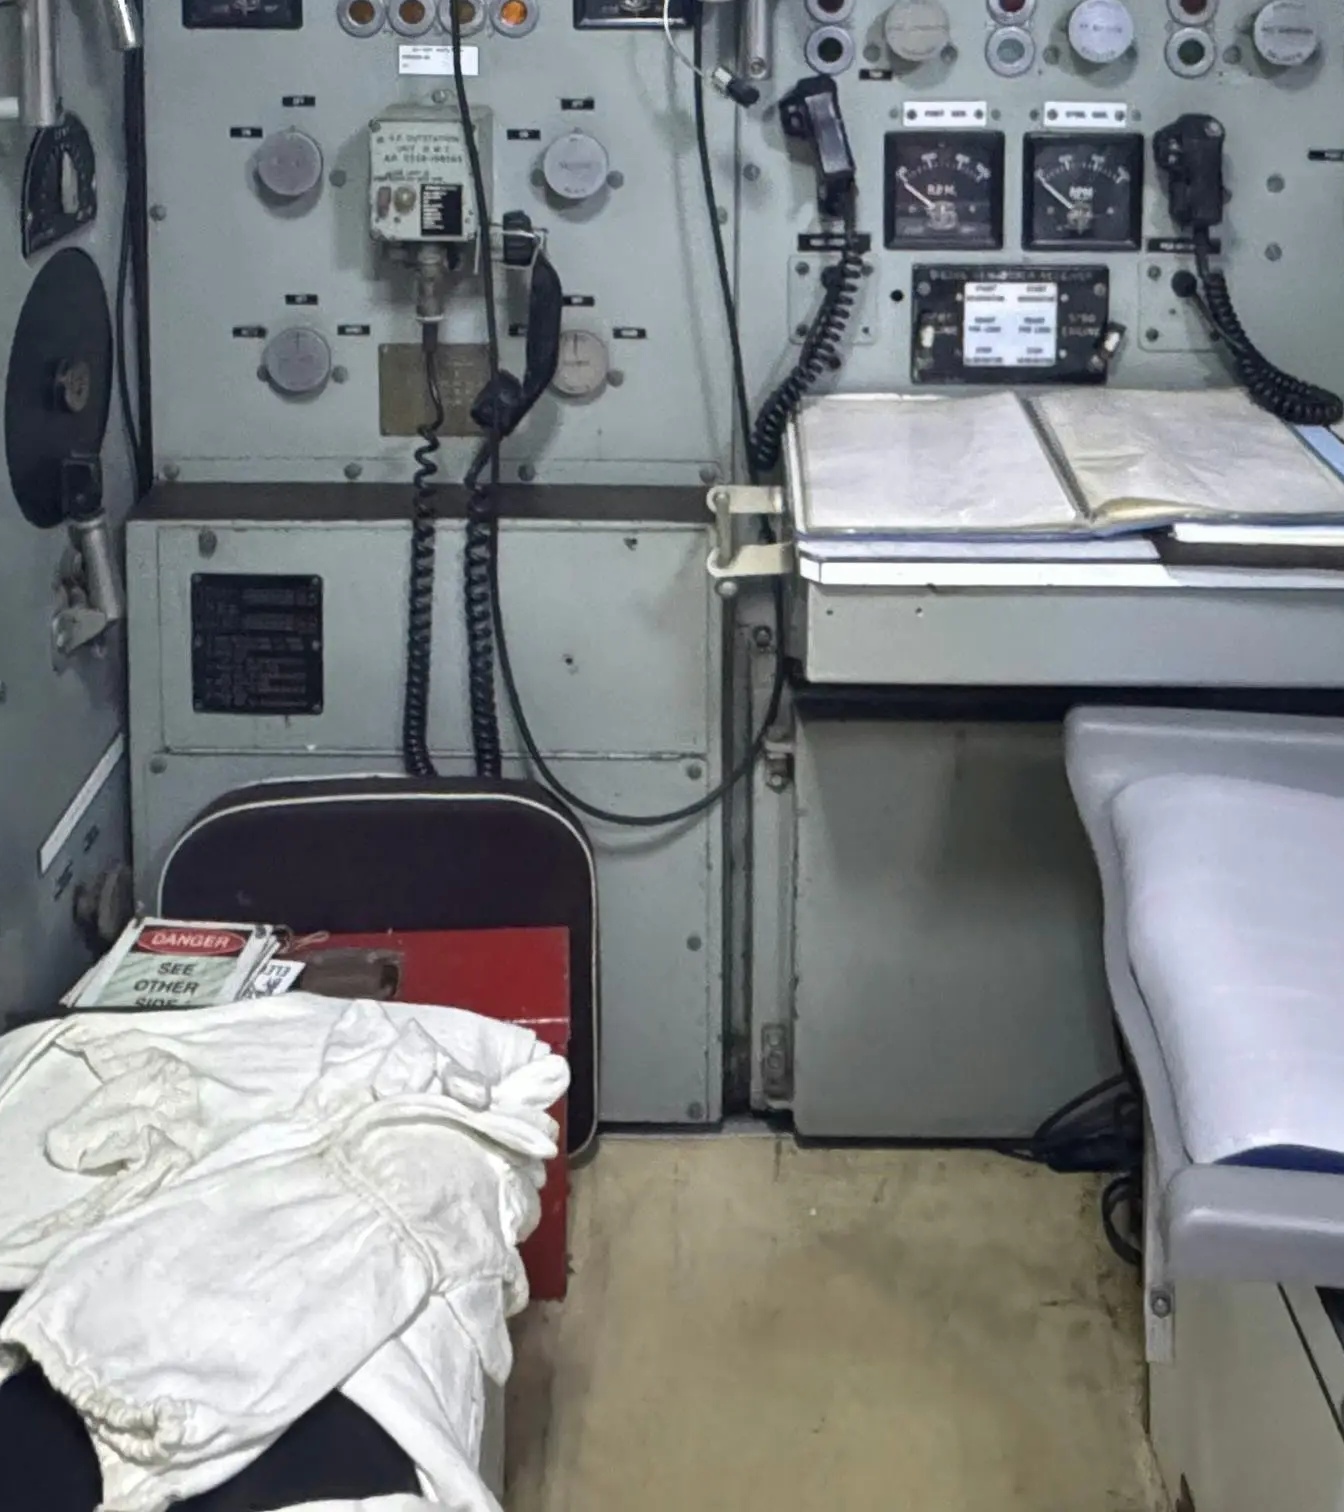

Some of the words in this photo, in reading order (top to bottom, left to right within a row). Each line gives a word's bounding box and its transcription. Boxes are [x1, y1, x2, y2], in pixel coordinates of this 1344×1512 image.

[151, 934, 231, 949] DANGER
[157, 962, 197, 976] SEE
[134, 979, 200, 995] OTHER
